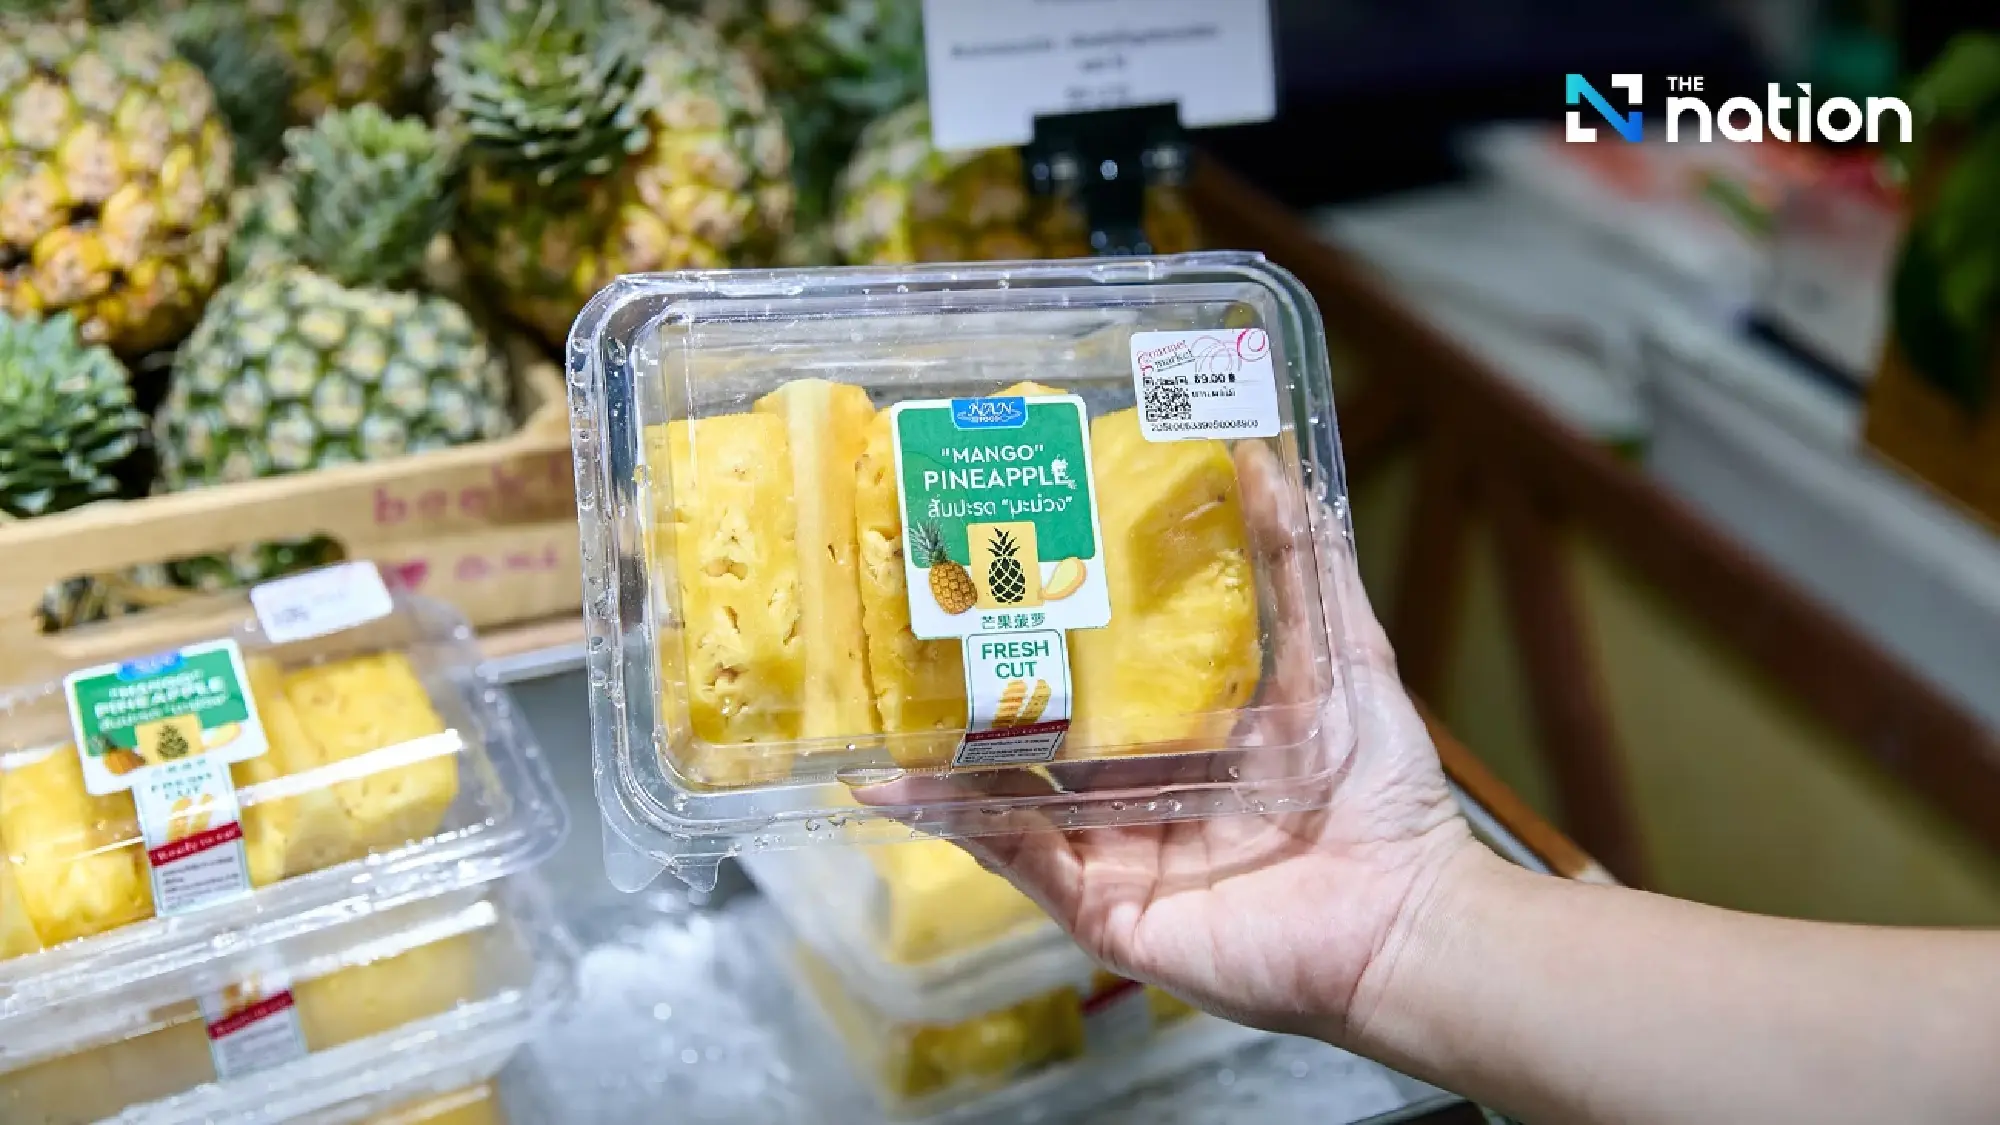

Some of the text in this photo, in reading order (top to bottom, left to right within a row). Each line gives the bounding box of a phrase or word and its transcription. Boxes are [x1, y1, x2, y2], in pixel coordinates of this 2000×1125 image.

[941, 444, 1044, 464] "MANGO"
[923, 464, 1069, 491] PINEAPPLE
[927, 493, 996, 519] สับปะรด
[981, 612, 1046, 630] 芒果菠萝
[981, 639, 1050, 660] FRESH
[994, 661, 1038, 679] CUT
